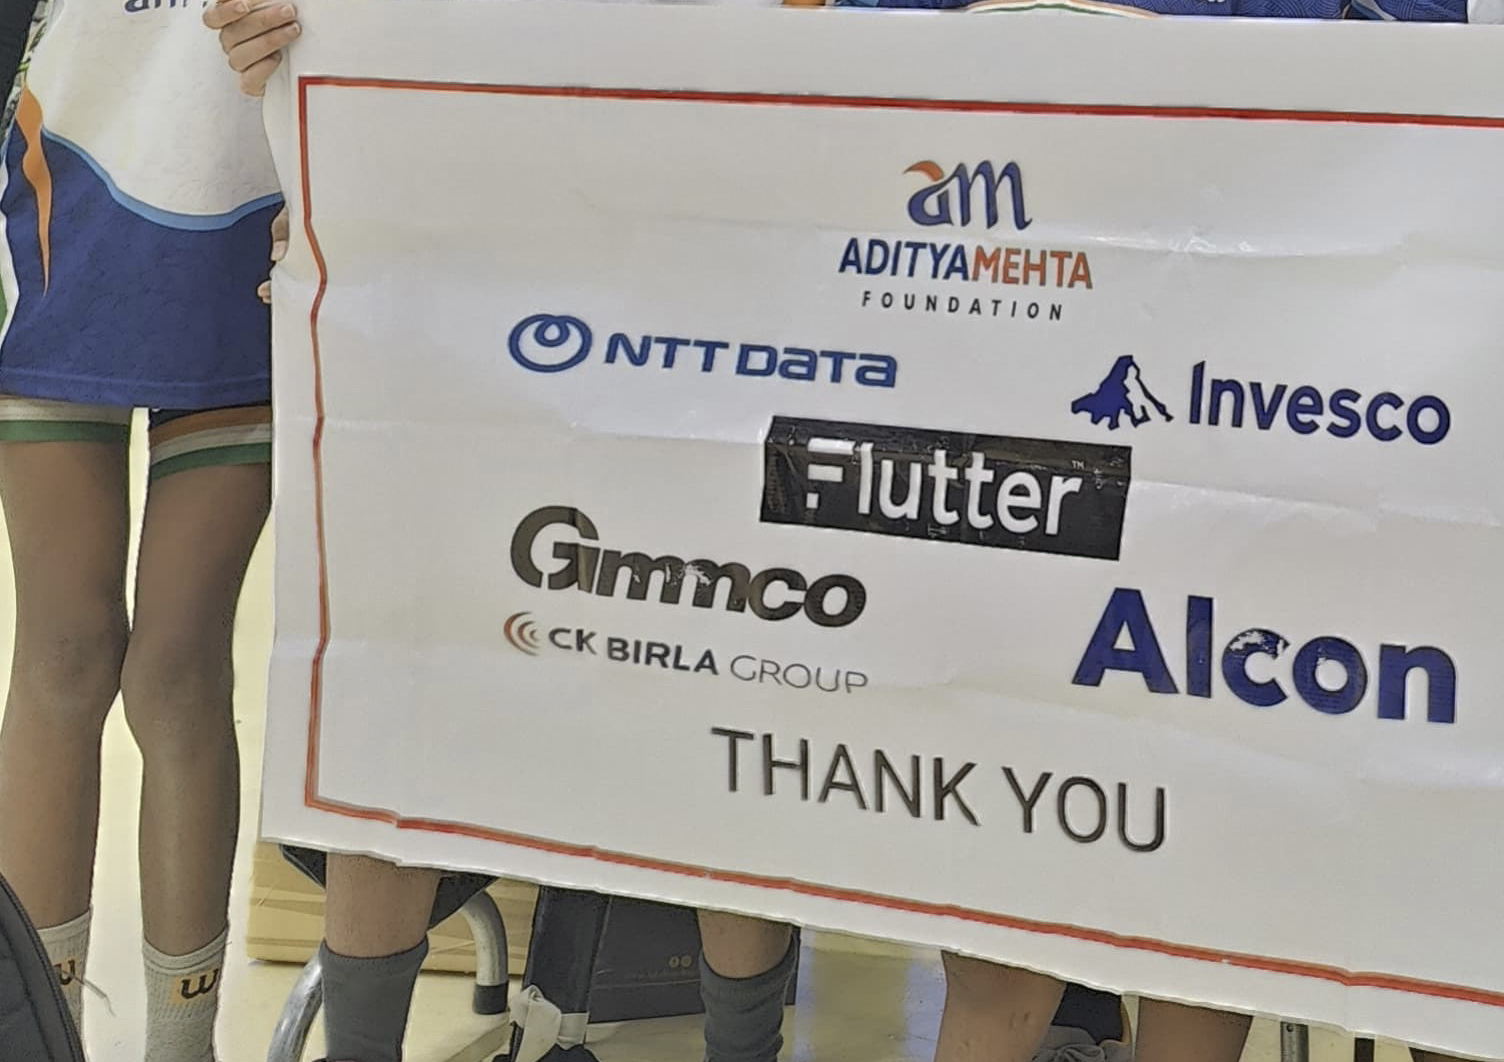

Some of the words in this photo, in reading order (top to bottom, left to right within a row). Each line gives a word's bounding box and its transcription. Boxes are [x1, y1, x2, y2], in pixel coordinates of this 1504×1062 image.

[903, 160, 1034, 231] am
[862, 291, 1063, 321] FOUNDATION
[604, 332, 730, 373] NTT
[1188, 359, 1452, 446] Invesco
[806, 438, 1084, 536] Flutter
[548, 628, 598, 656] CK
[606, 636, 720, 676] BIRLA
[730, 654, 869, 695] GROUP
[1071, 586, 1459, 726] Alcon
[711, 726, 982, 827] THANK
[1001, 766, 1167, 853] YOU
